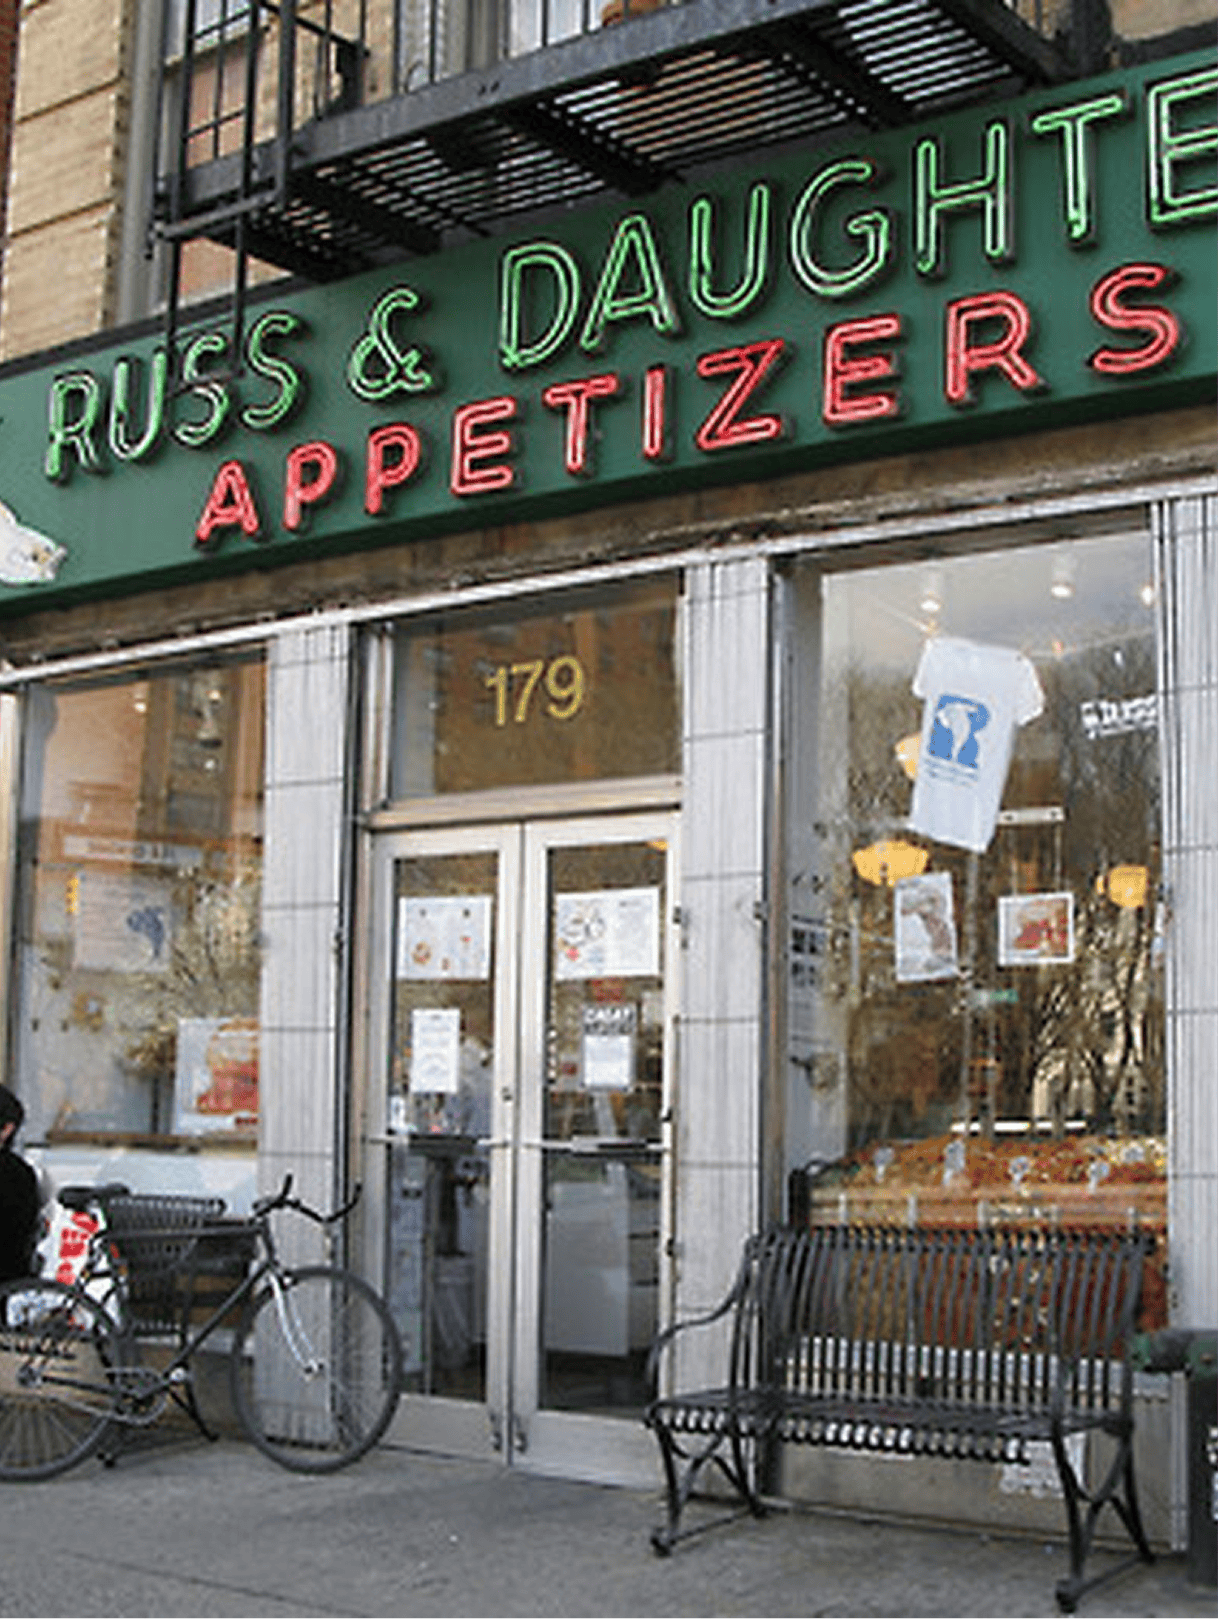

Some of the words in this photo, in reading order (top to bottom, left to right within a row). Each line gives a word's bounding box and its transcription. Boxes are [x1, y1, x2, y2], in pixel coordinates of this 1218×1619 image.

[46, 312, 298, 479] RUSS
[348, 287, 432, 400] &
[499, 70, 1218, 369] DAUGHTE
[195, 265, 1180, 545] APPETIZERS
[485, 655, 584, 725] 179
